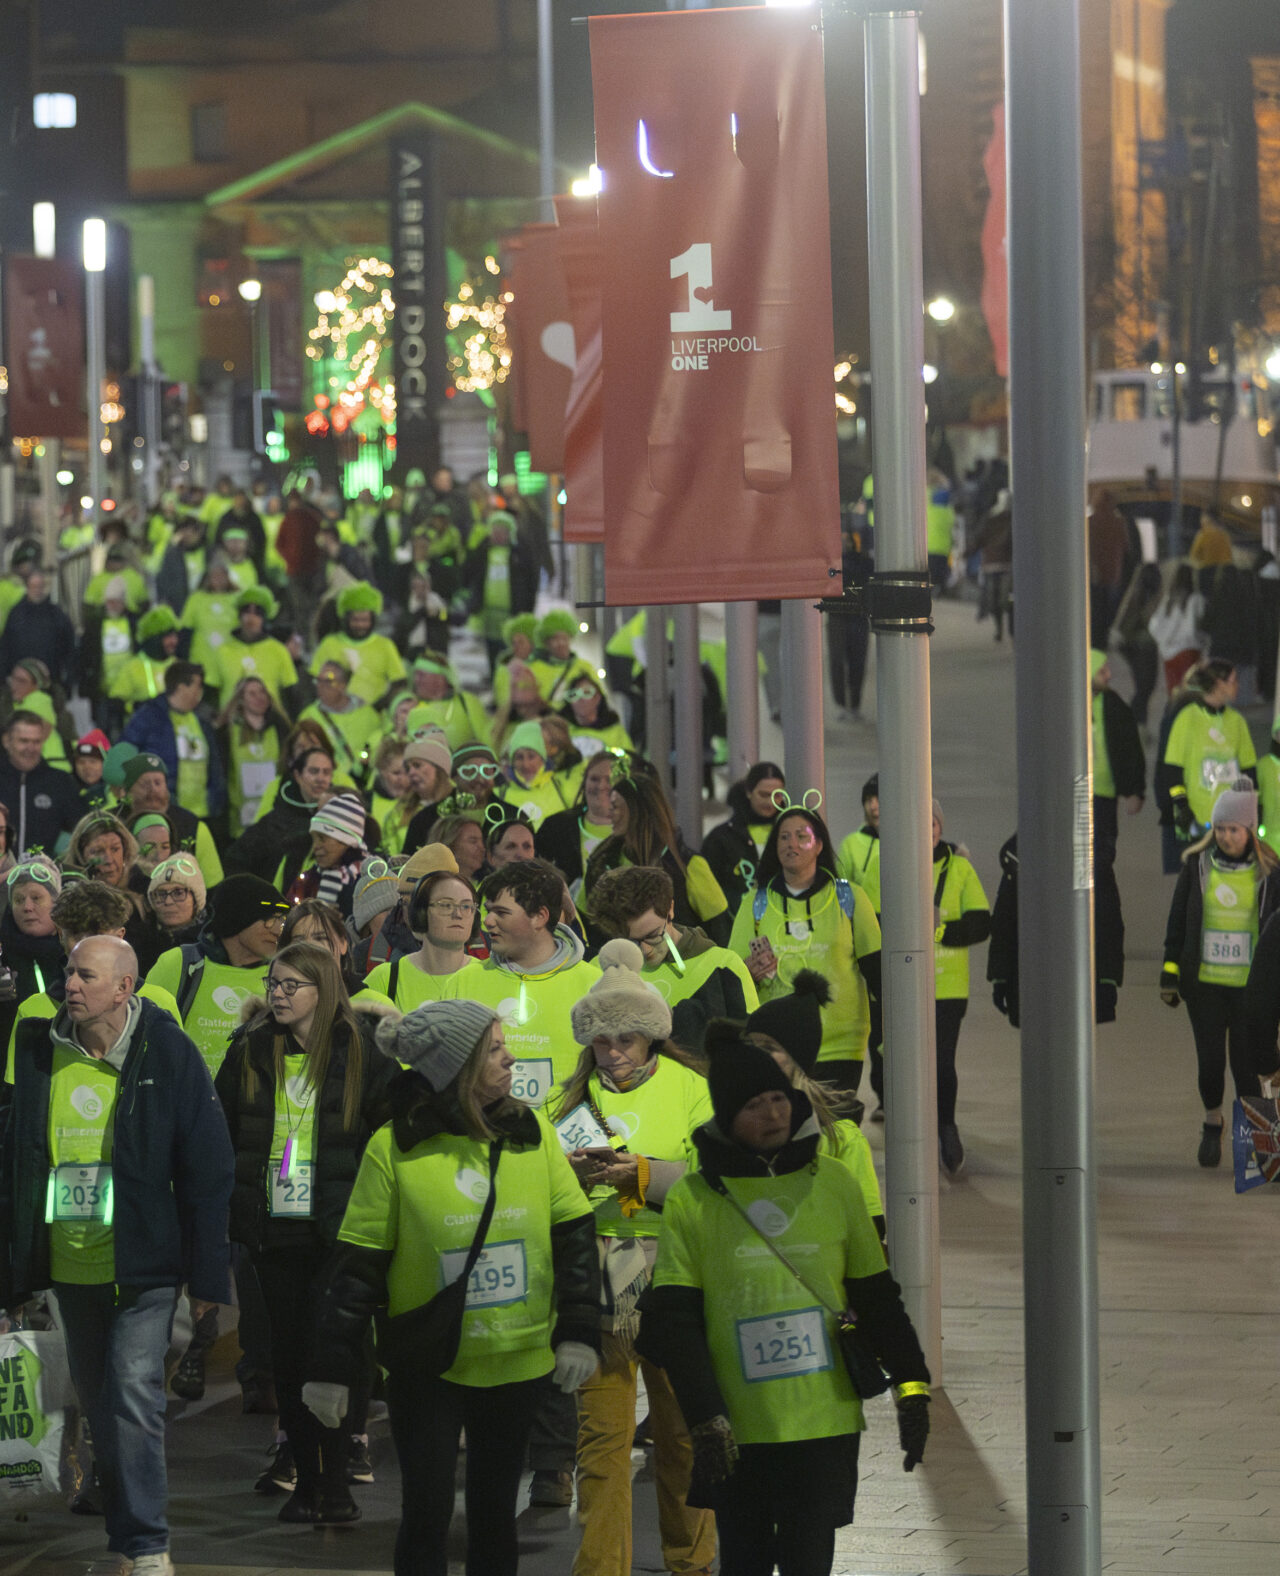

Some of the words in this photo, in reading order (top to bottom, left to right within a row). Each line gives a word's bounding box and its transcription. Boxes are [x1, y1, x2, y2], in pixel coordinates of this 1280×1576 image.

[399, 152, 425, 296] ALBERT
[671, 336, 763, 355] LIVERPOOL
[400, 305, 427, 422] DOCK
[671, 356, 710, 371] ONE
[1211, 943, 1241, 958] 388
[511, 1078, 539, 1098] 60
[560, 1123, 593, 1149] 130
[283, 1183, 310, 1203] 22
[466, 1264, 516, 1294] 195
[754, 1333, 817, 1366] 1251
[12, 1384, 30, 1412] A
